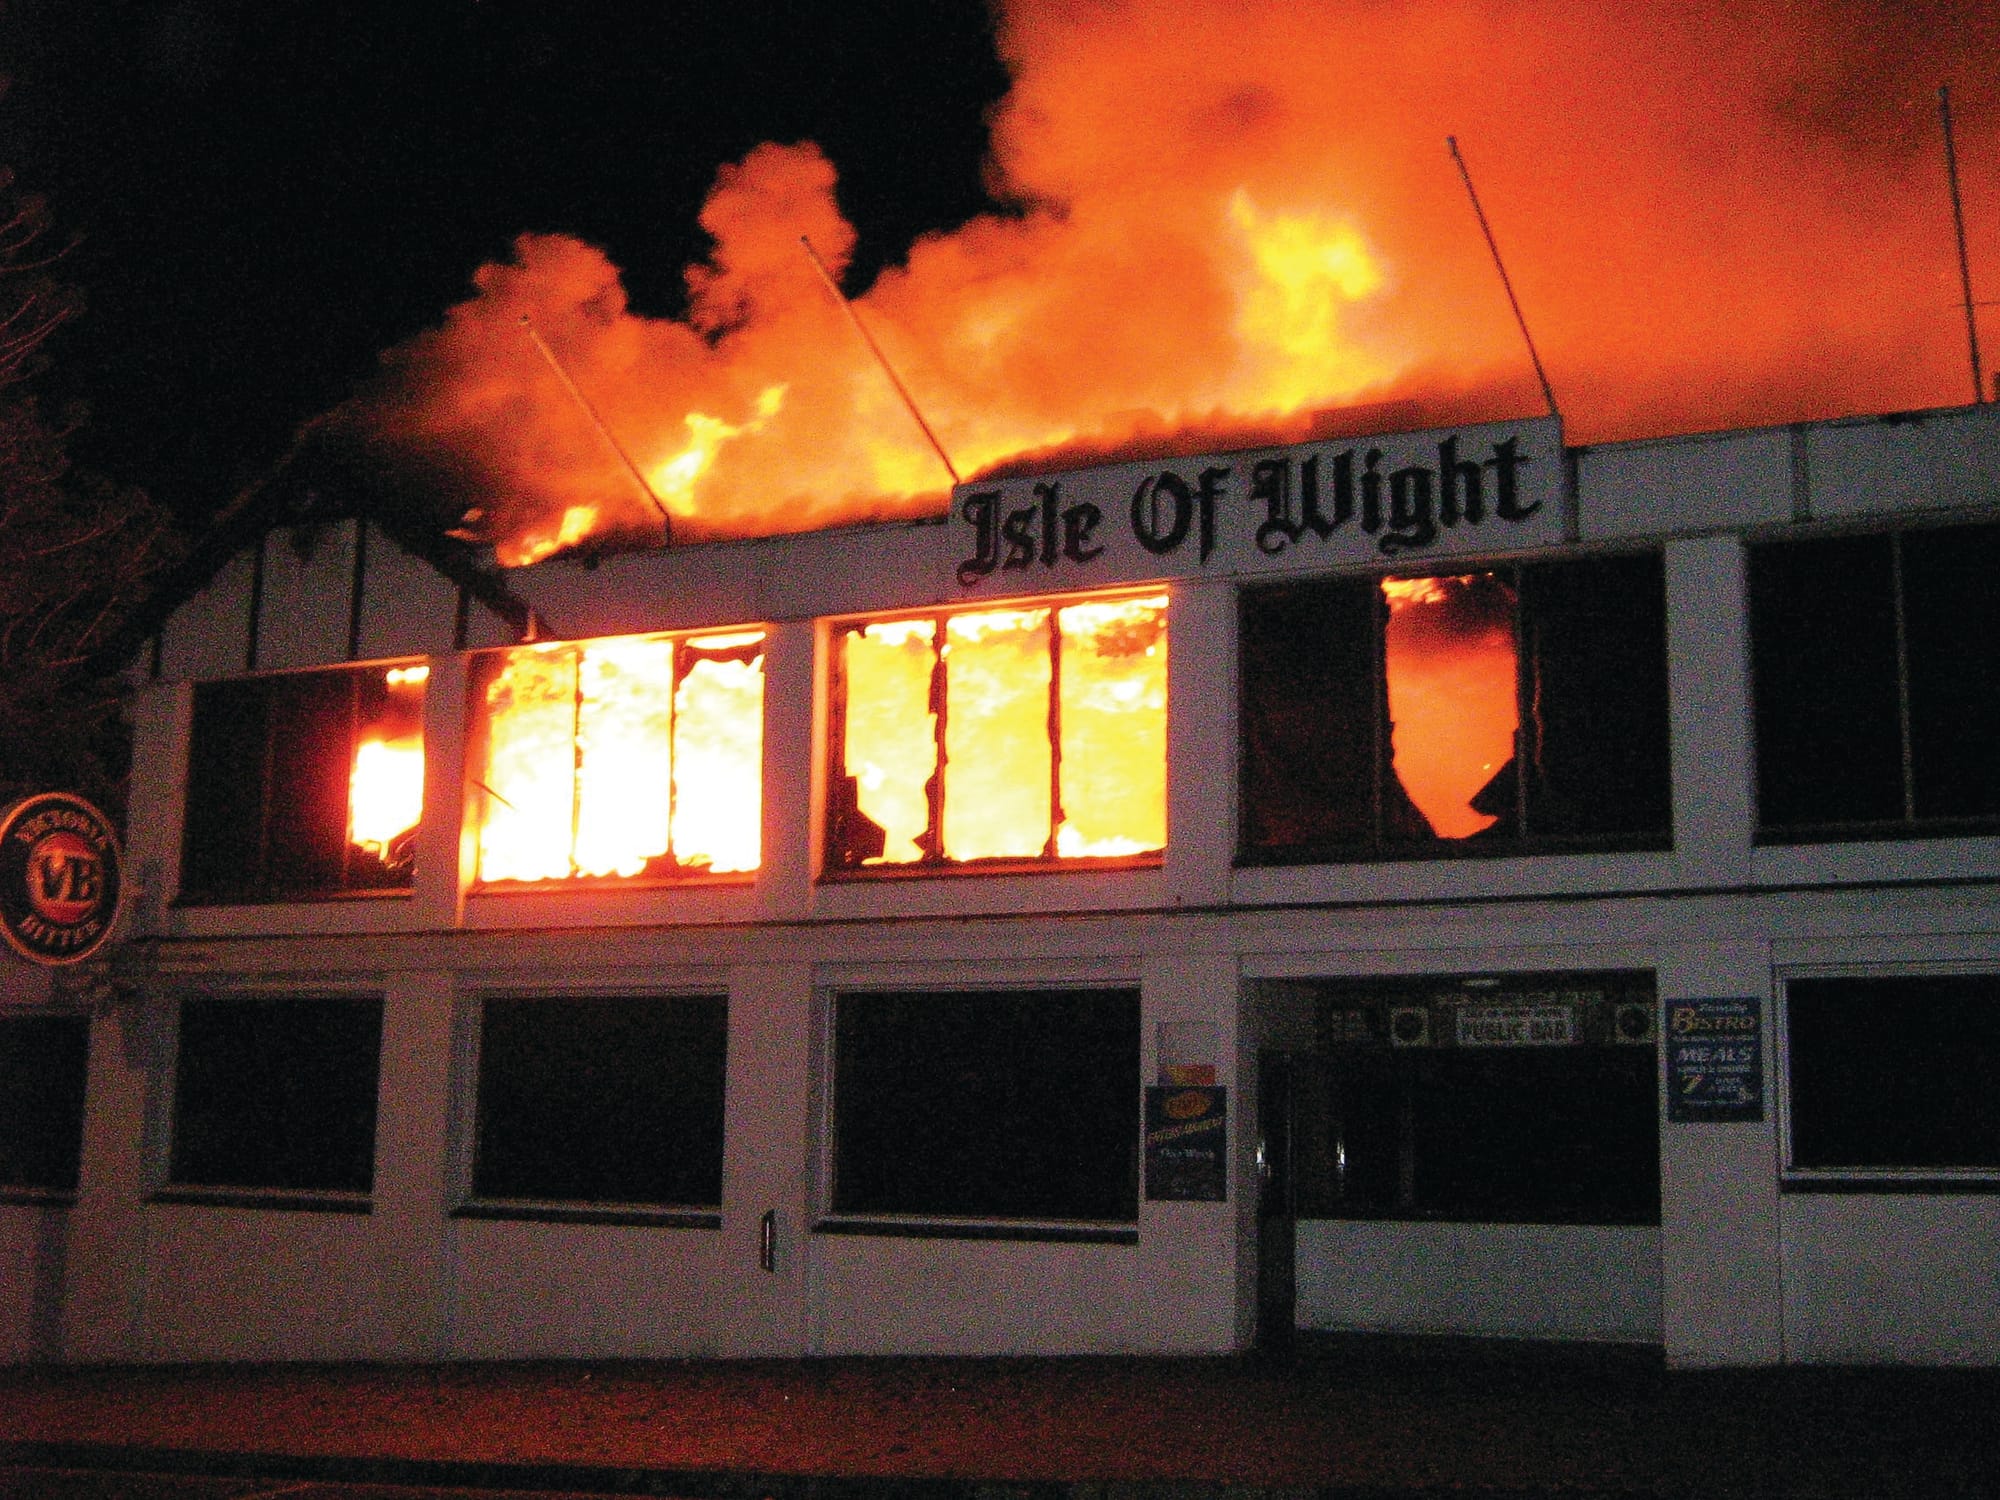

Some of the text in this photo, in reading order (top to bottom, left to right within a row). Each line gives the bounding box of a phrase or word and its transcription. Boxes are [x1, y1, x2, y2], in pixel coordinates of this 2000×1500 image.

[956, 435, 1543, 586] Isle Of Wight
[36, 848, 101, 904] VB
[18, 913, 101, 946] BITTER
[1676, 1046, 1754, 1063] MEALS
